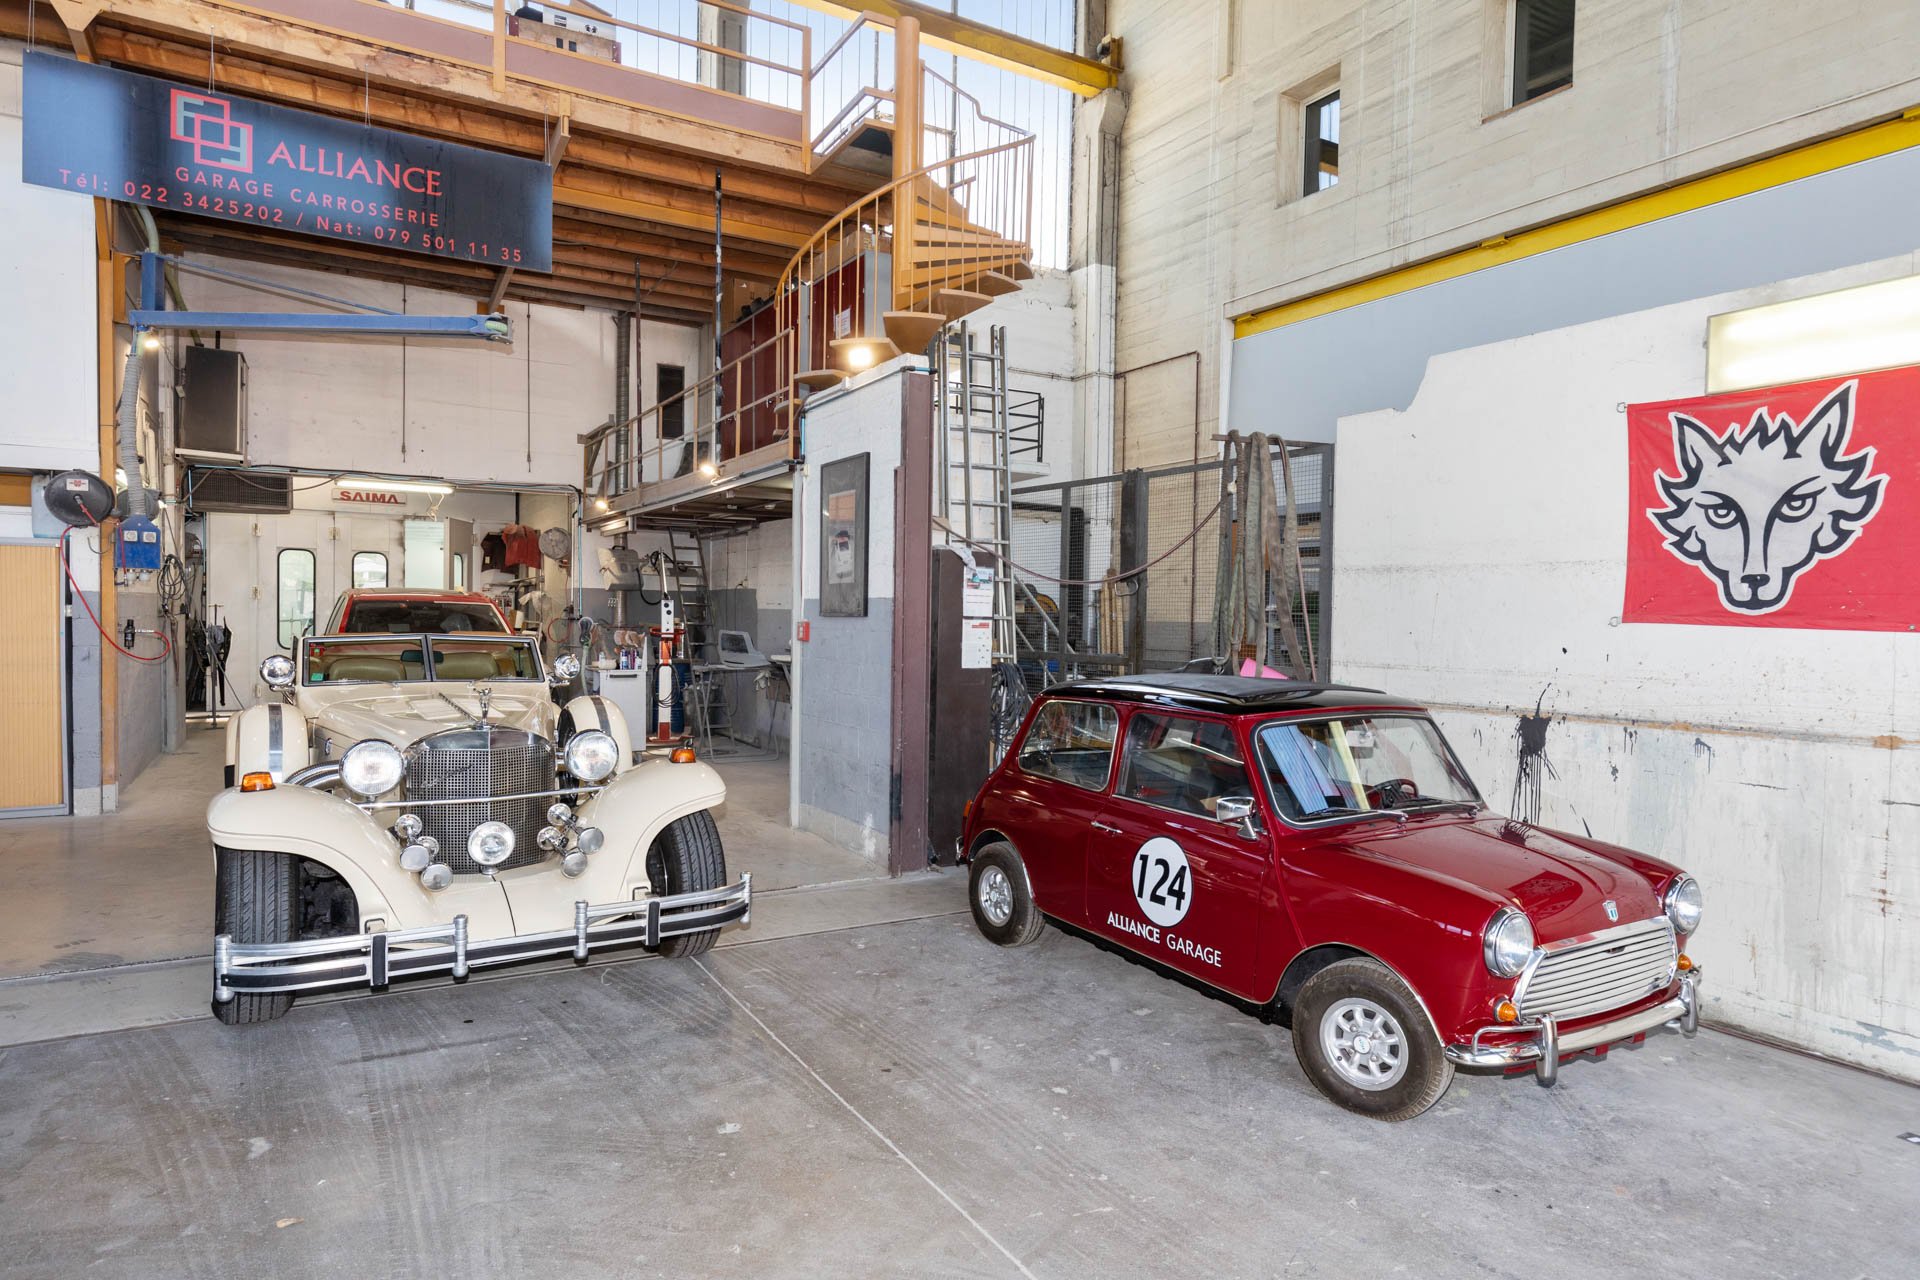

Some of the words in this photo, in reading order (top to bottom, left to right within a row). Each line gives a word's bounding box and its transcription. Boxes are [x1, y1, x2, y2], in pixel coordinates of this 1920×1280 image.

[175, 166, 273, 198] GARAGE
[290, 188, 440, 228] CARROSSERIE
[266, 141, 443, 197] ALLIANCE
[58, 168, 108, 192] Tél:
[124, 181, 168, 203] 022
[183, 192, 283, 223] 3425202
[295, 212, 304, 226] /
[316, 215, 362, 236] Nat:
[374, 226, 411, 244] 079
[423, 233, 456, 252] 501
[468, 242, 488, 257] 11
[501, 247, 522, 263] 35
[340, 490, 399, 505] SAIMA
[1136, 854, 1188, 912] 124
[1106, 911, 1161, 944] ALLIANCE
[1166, 933, 1222, 968] GARAGE
